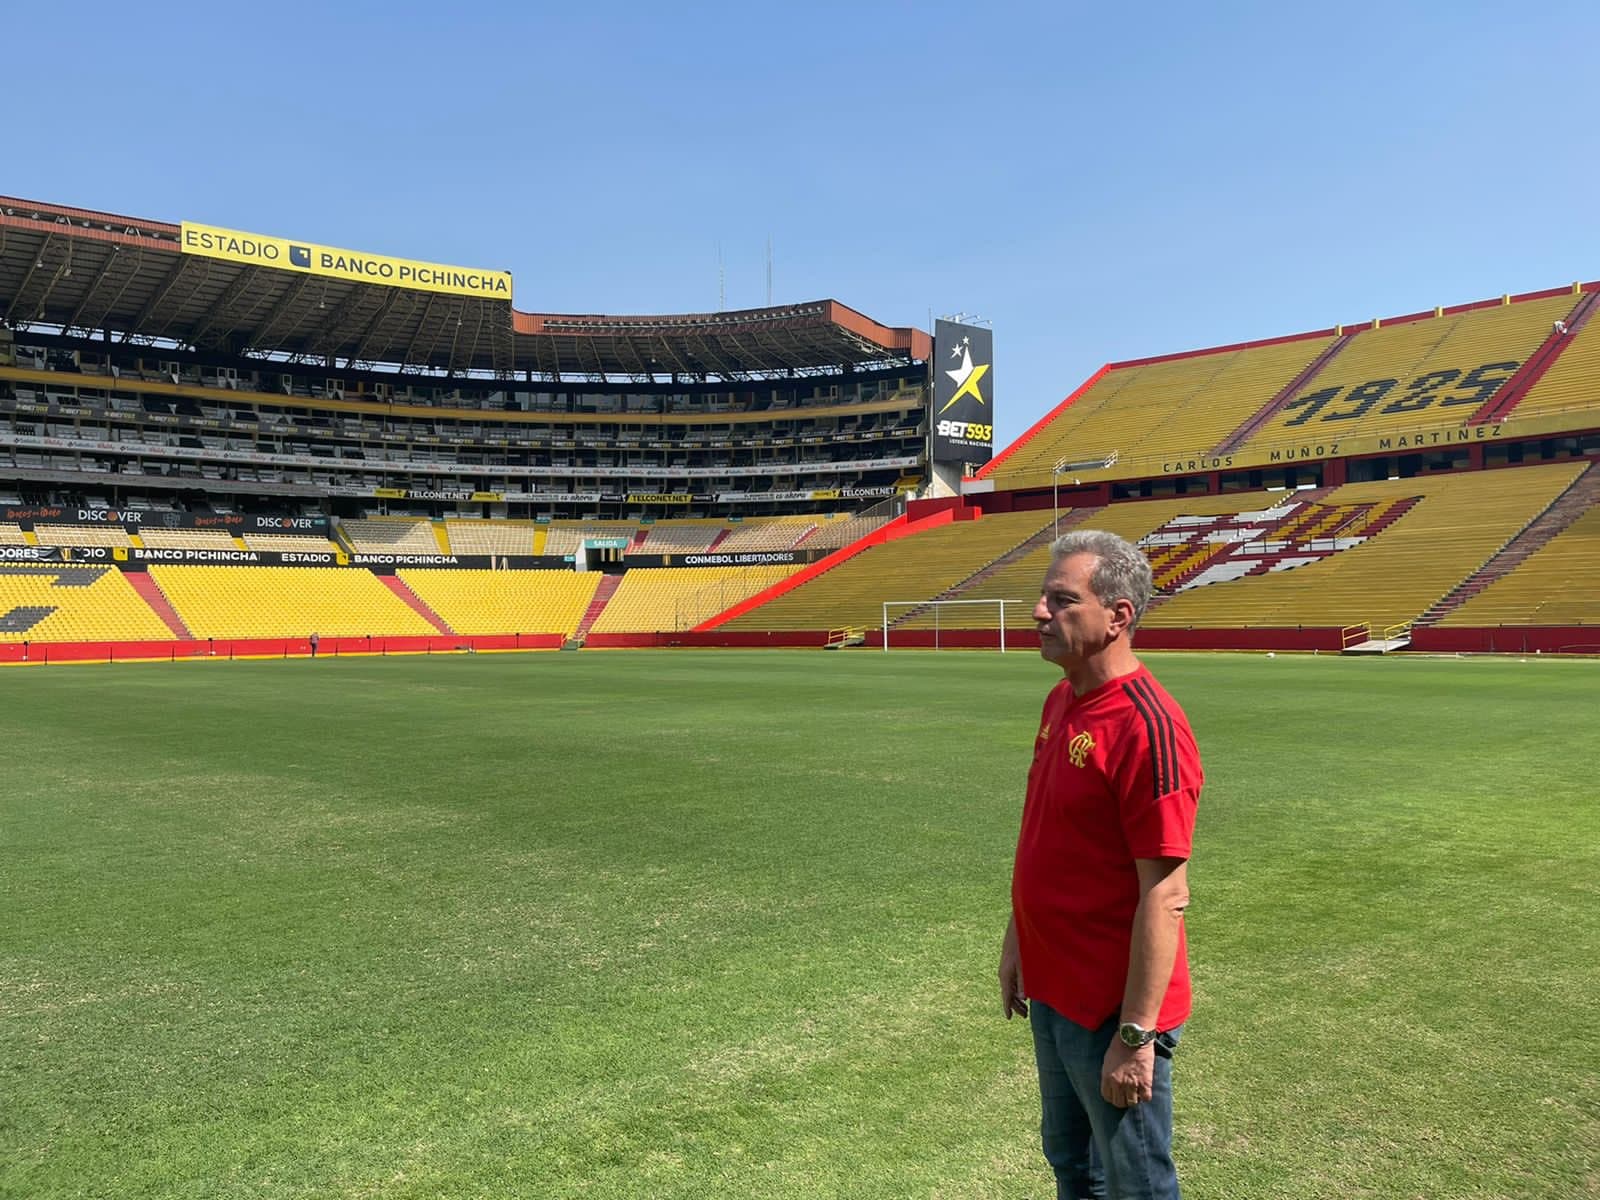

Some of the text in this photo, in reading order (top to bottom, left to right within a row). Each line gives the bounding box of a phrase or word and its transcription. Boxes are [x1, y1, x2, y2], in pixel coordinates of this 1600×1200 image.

[186, 230, 508, 292] ESTADIO BANCO PICHINCHA
[1284, 361, 1520, 427] 1985
[936, 420, 993, 441] BET593
[1164, 425, 1502, 473] CARLOS MUÑOZ MARTINEZ
[409, 490, 470, 500] TELCONET.NET
[842, 487, 896, 497] TELCONET.NET
[78, 509, 142, 522] DISCOVER
[257, 517, 312, 529] DISCOVER
[135, 550, 183, 560] BANCO
[186, 551, 258, 561] PICHINCHA
[281, 553, 458, 564] ESTADIO BANCO PICHINCHA
[685, 553, 794, 564] CONMEBOL LIBERTADORES
